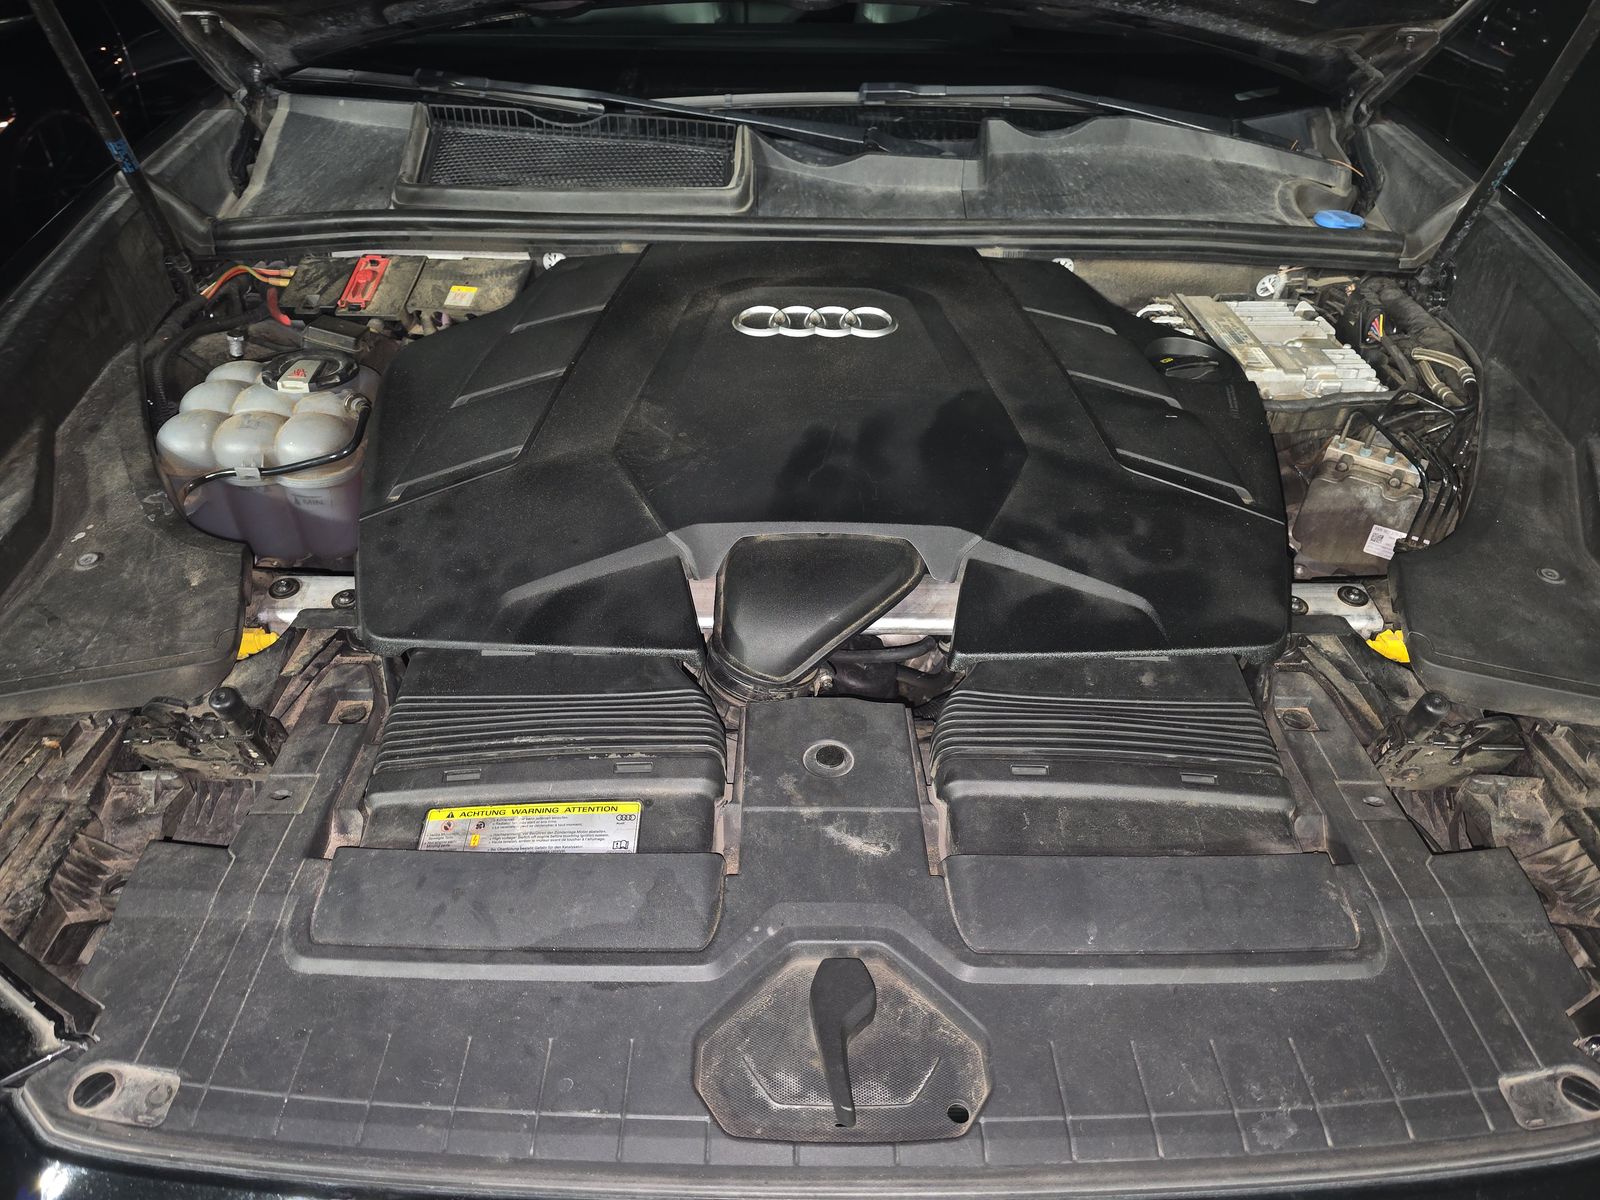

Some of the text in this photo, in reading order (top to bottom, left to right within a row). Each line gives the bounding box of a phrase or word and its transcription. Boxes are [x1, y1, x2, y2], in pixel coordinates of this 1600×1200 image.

[459, 805, 618, 817] ACHTUNG WARNING ATTENTION
